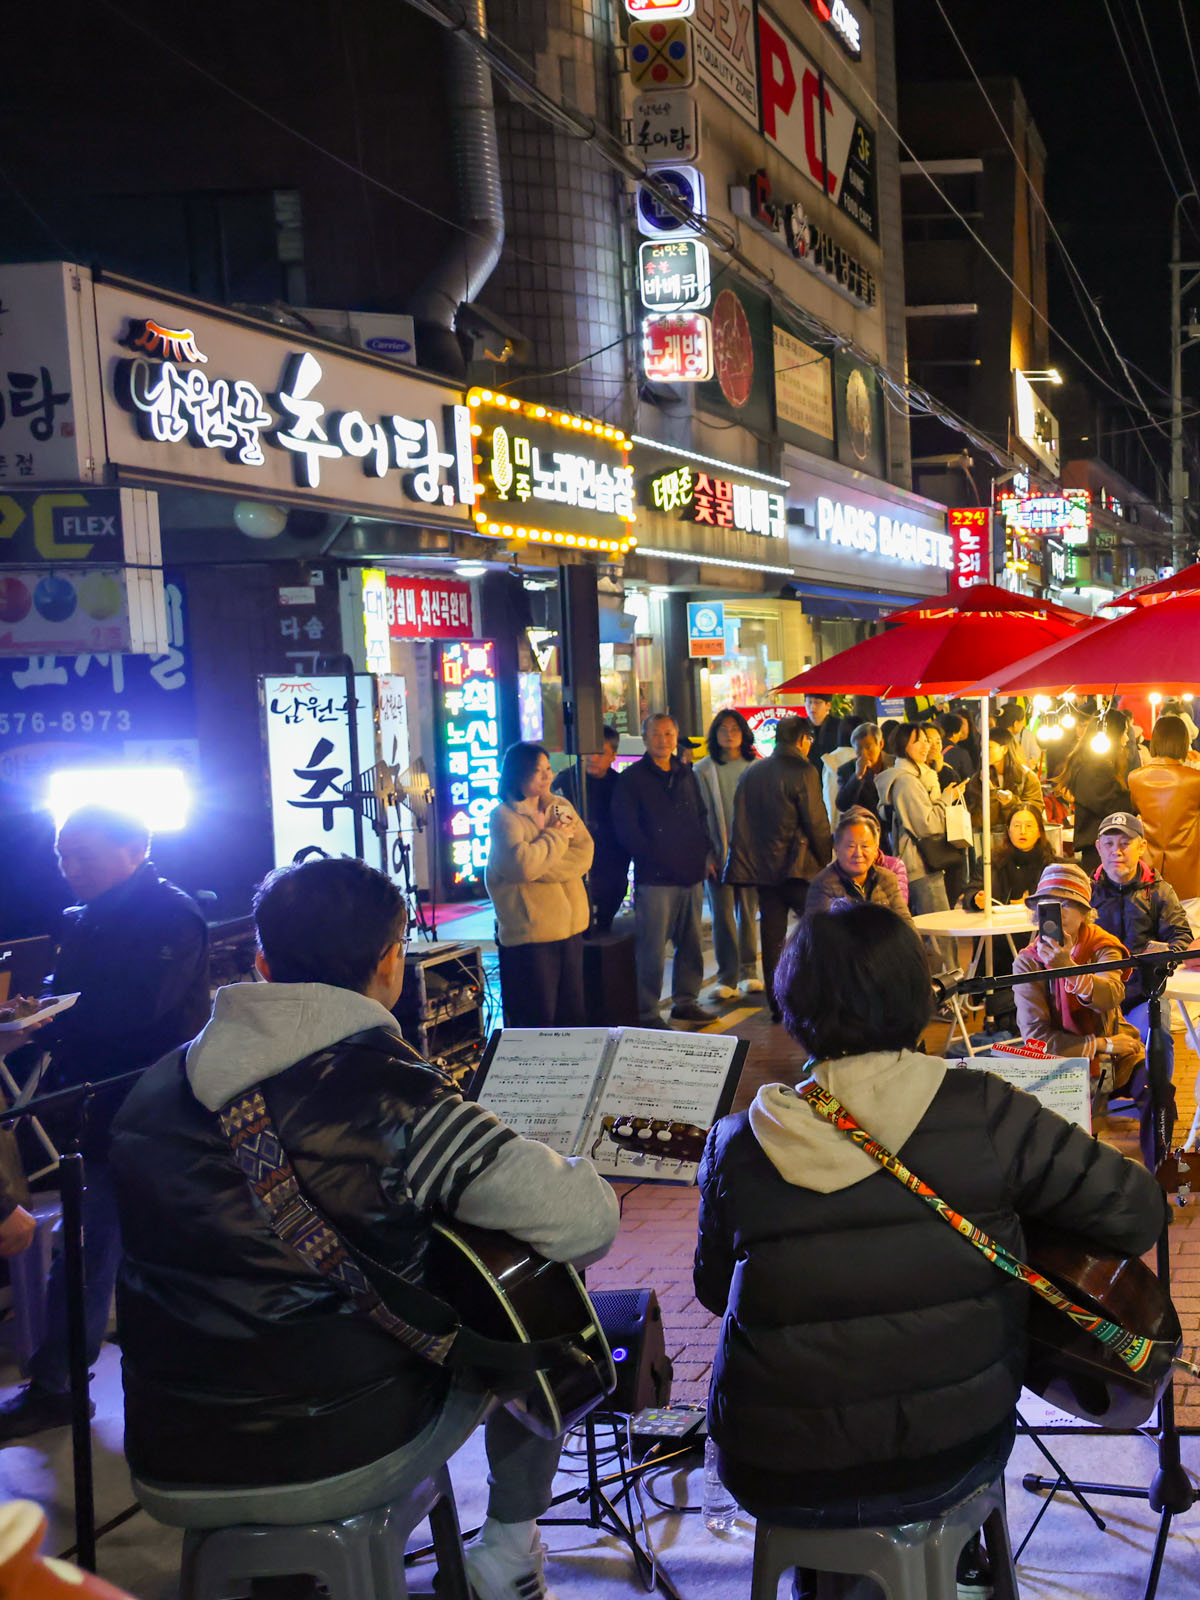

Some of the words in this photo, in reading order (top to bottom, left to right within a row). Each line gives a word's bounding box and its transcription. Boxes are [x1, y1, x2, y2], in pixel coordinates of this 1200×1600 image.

[759, 14, 838, 196] PC
[637, 119, 691, 154] 추어탕
[857, 127, 871, 166] 3F
[652, 243, 689, 258] 더맛존
[645, 273, 698, 302] 바베큐
[370, 340, 406, 350] Carrier
[647, 334, 699, 372] 노래방
[0, 366, 71, 442] 탕
[276, 352, 455, 503] 추어탕
[693, 472, 734, 528] 숯불
[63, 516, 116, 536] FLEX
[818, 496, 877, 552] PARIS
[878, 515, 955, 571] BAGUETTE
[0, 709, 131, 734] 576-8973
